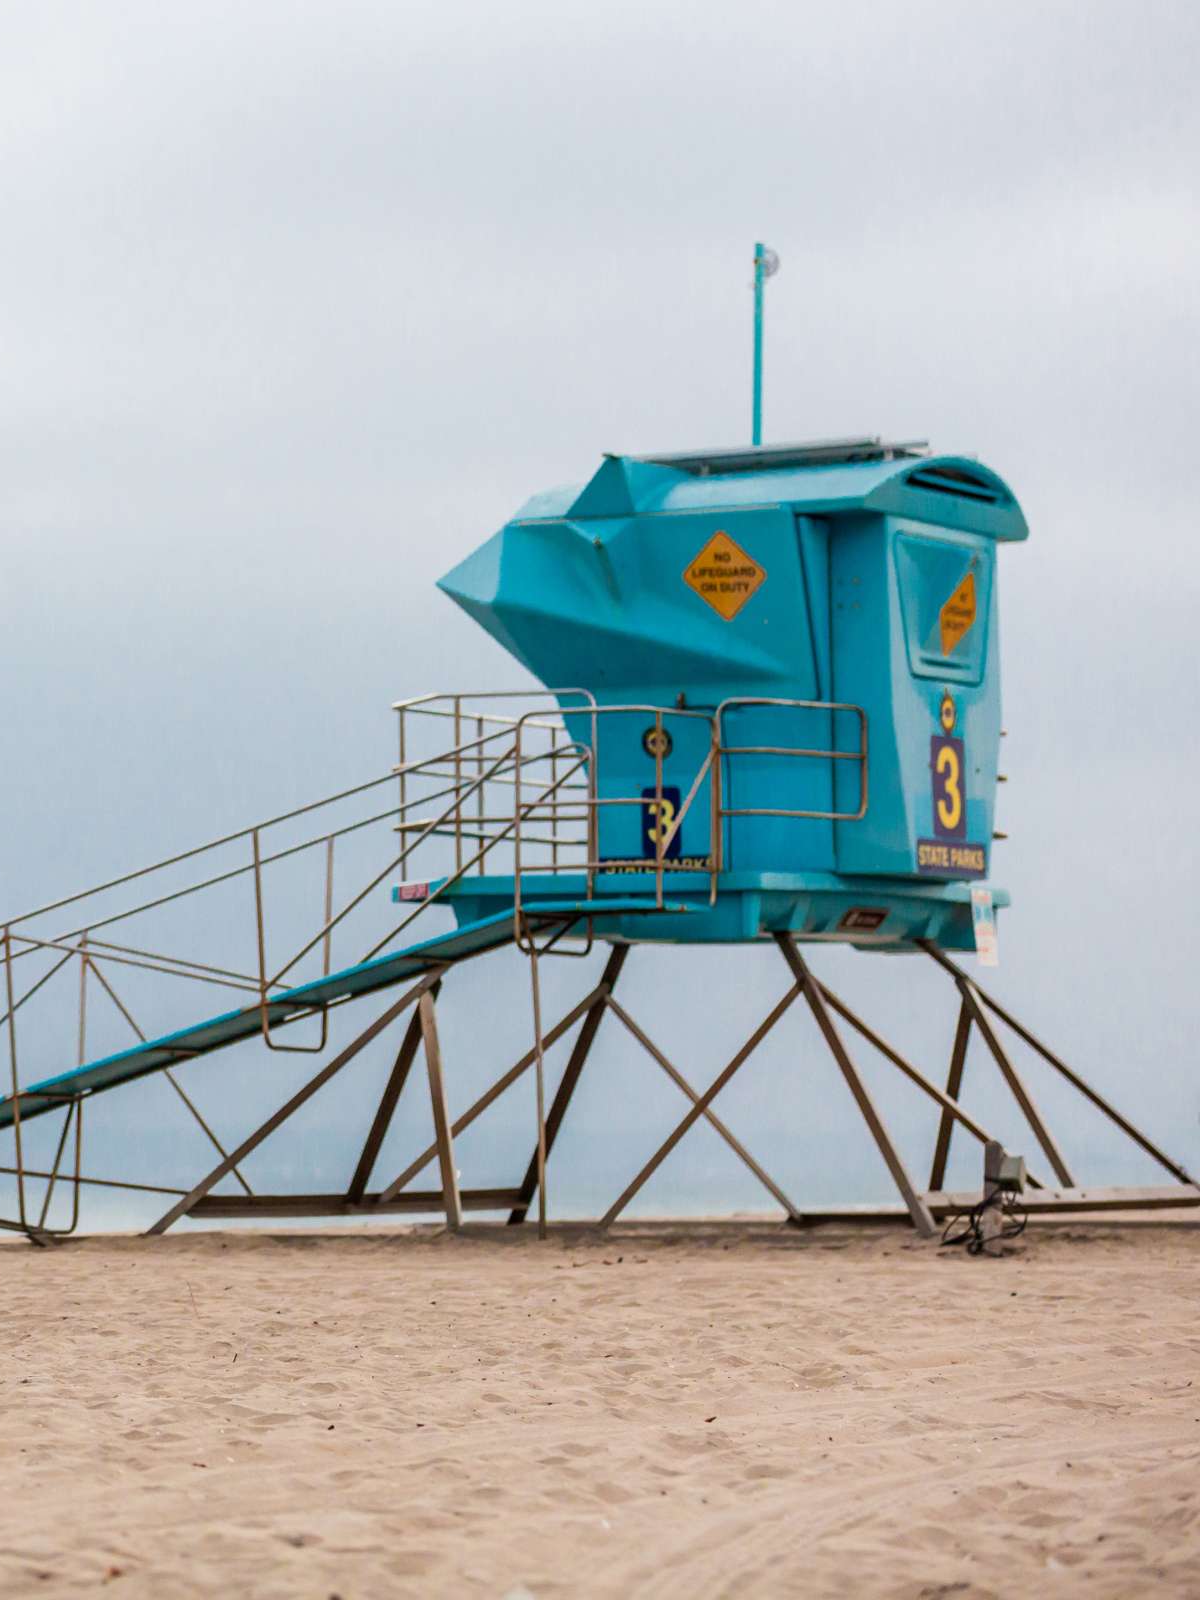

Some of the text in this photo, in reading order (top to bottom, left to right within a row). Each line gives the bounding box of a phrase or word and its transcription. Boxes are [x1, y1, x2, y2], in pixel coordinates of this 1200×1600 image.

[713, 552, 731, 563] NO
[691, 566, 757, 578] LIFEGUARD
[701, 582, 750, 592] ON DUTY
[936, 746, 961, 829] 3
[648, 799, 675, 844] 3
[918, 844, 984, 870] STATE PARKS
